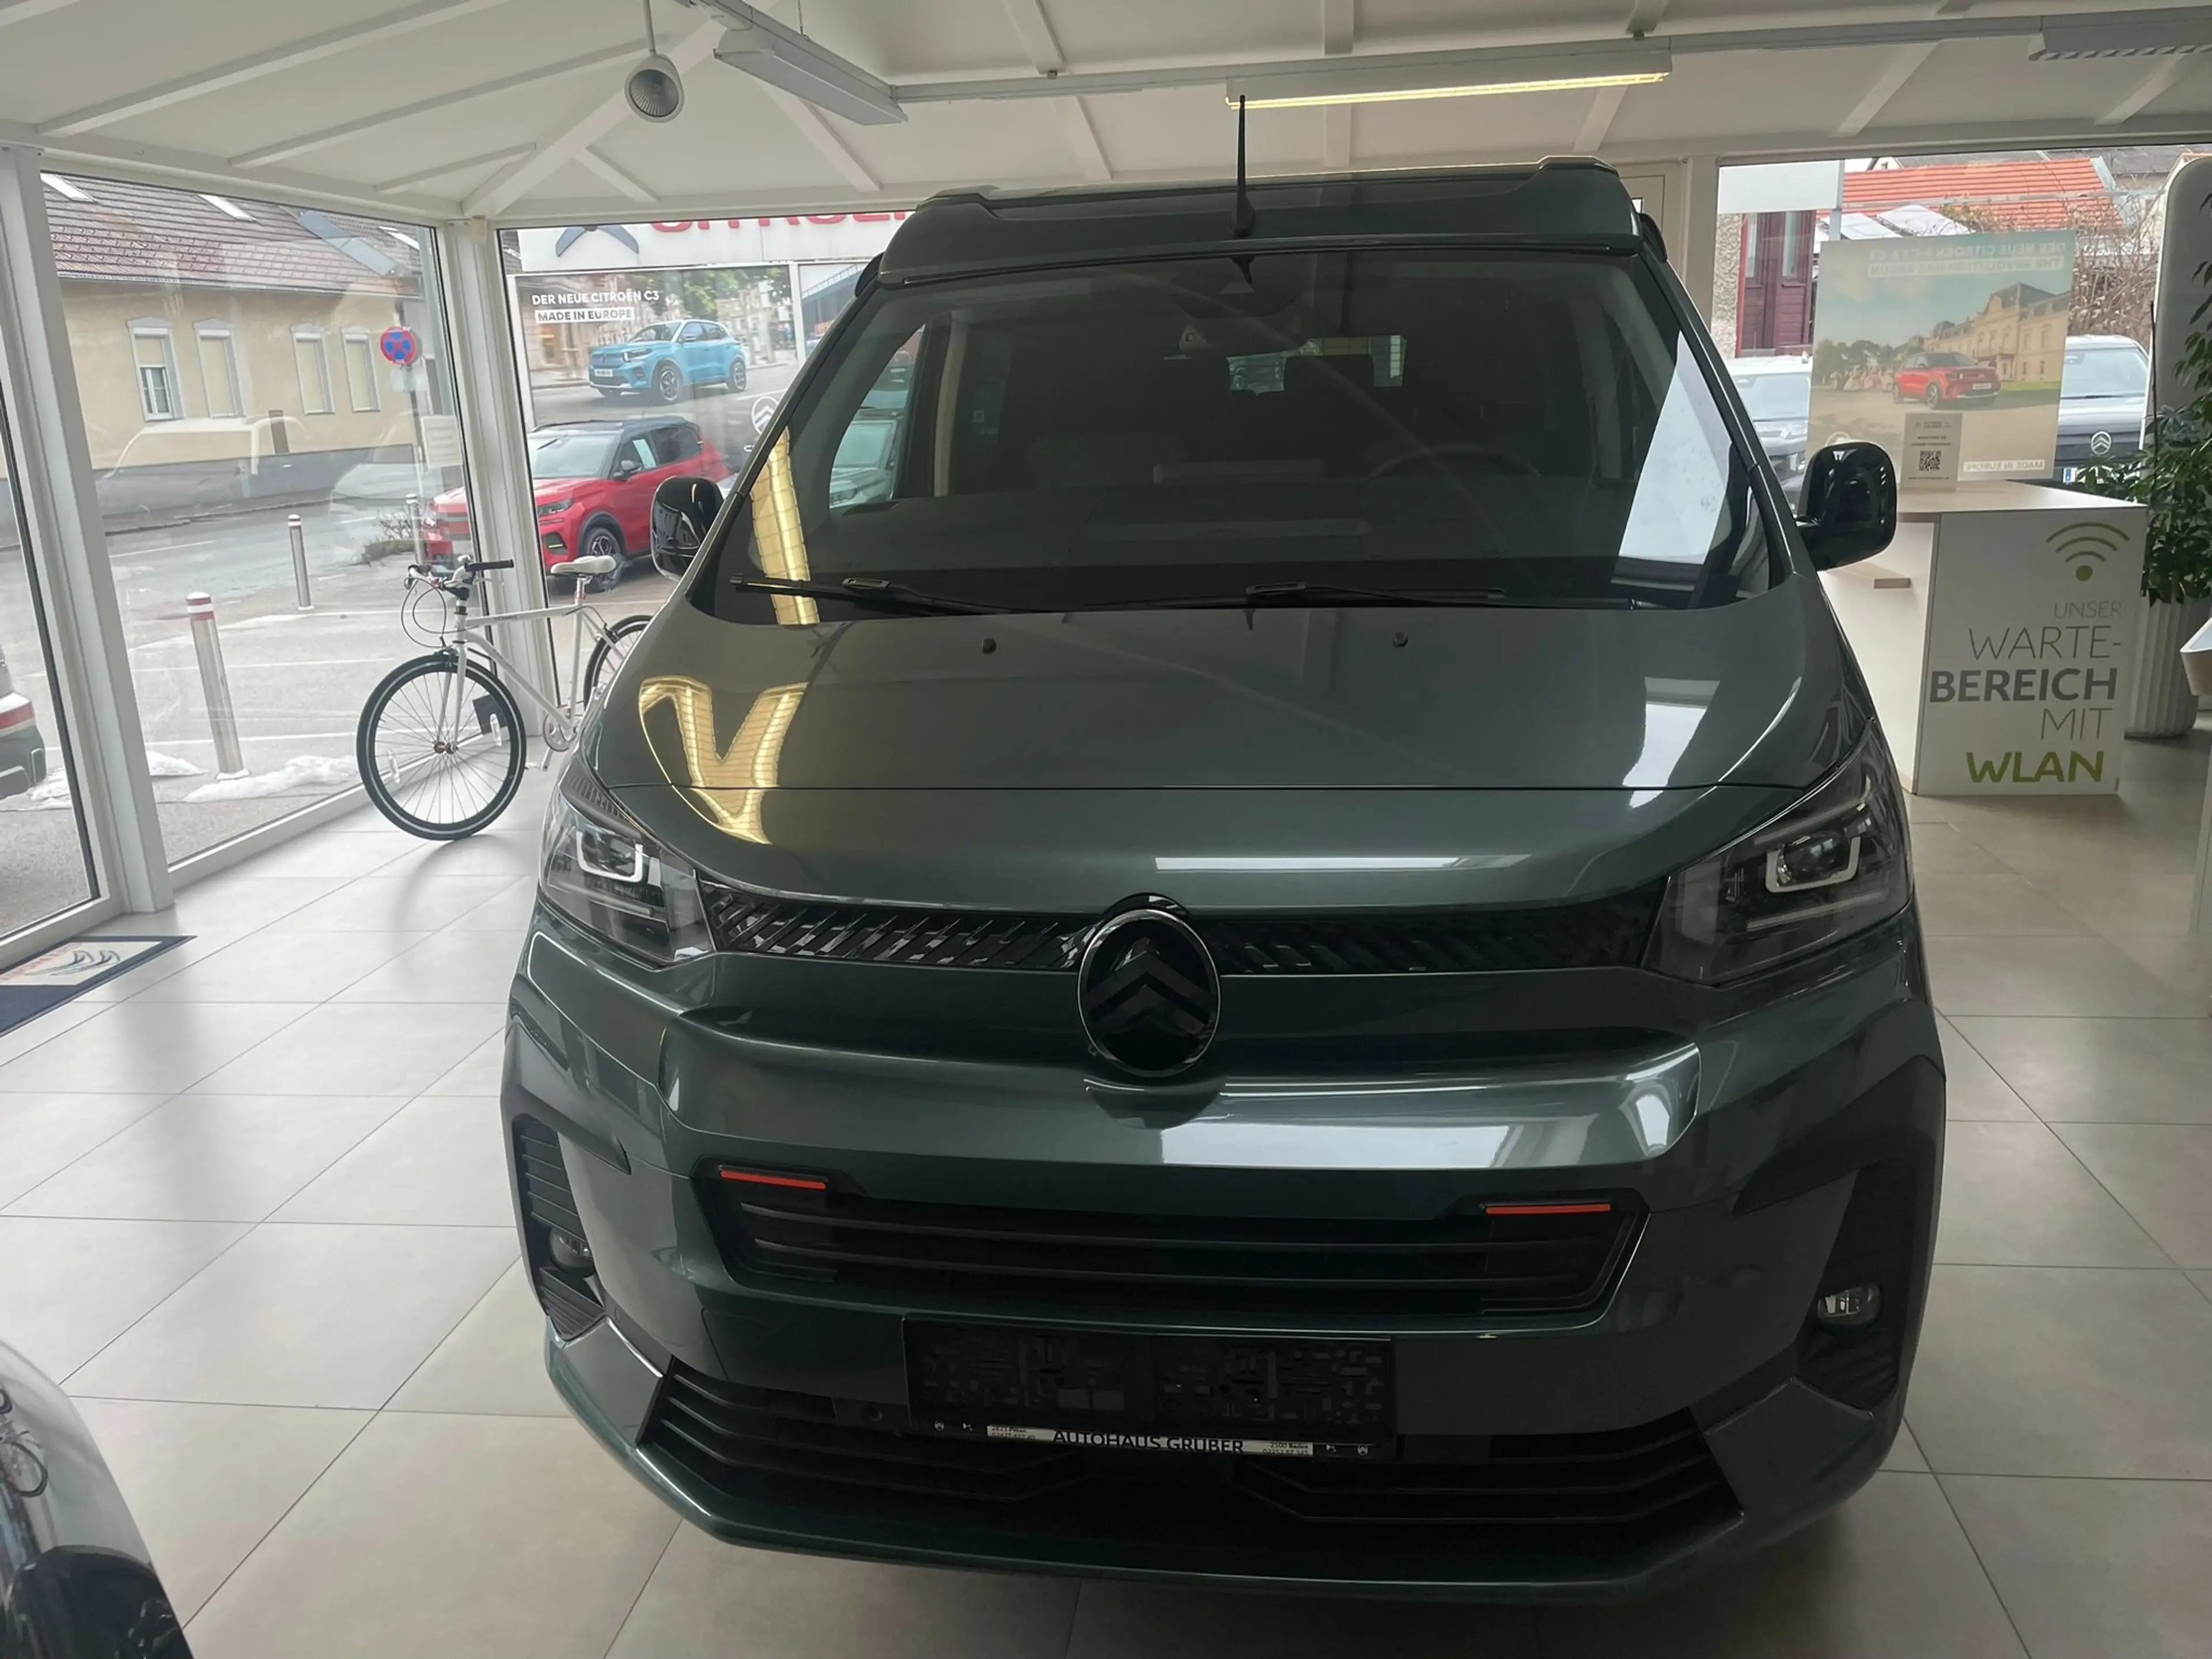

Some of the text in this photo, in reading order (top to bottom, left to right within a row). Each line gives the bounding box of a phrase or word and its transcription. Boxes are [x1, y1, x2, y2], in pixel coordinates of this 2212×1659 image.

[532, 289, 660, 305] DER NEUE CITROËN C3
[537, 309, 632, 321] MADE IN EUROPE
[2054, 600, 2122, 619] UNSER
[1968, 625, 2122, 660] WARTE-
[1930, 668, 2118, 702] BEREICH
[2041, 707, 2113, 740] MIT
[1966, 751, 2104, 783] WLAN
[1053, 1431, 1160, 1449] AUTOHAUS
[1167, 1437, 1244, 1453] GRUBER
